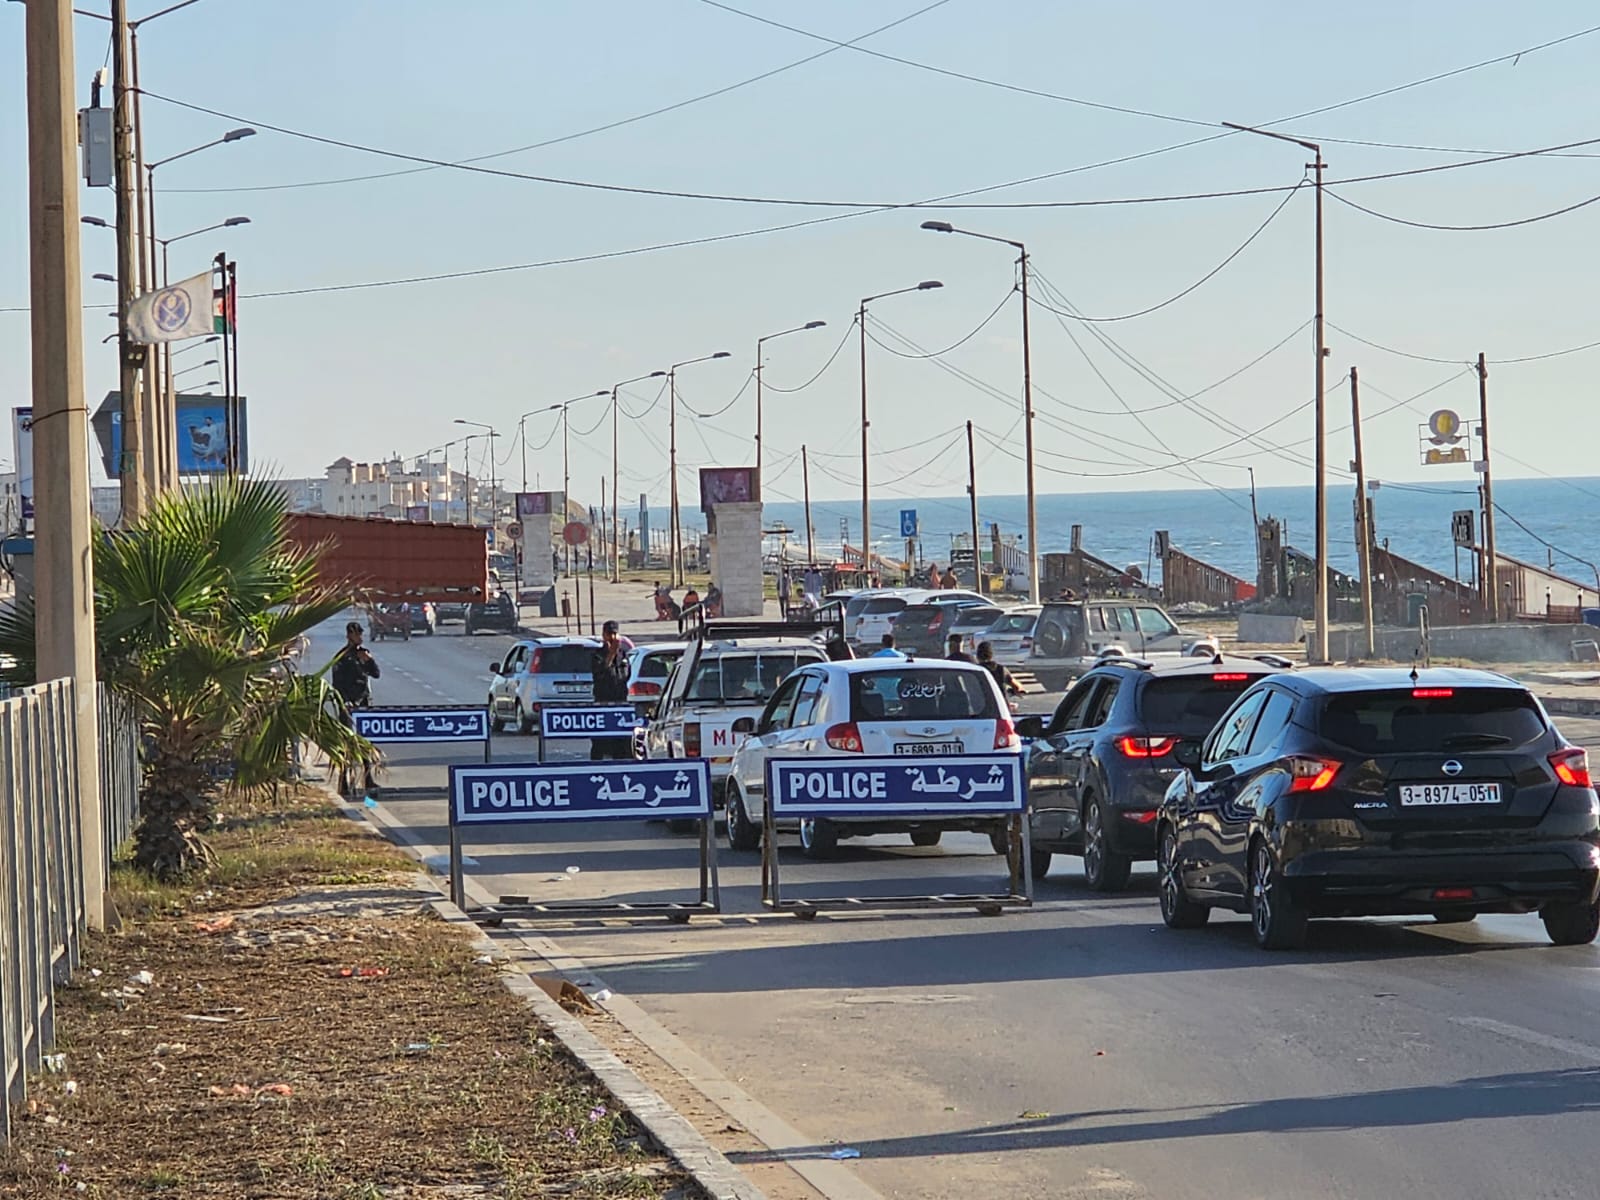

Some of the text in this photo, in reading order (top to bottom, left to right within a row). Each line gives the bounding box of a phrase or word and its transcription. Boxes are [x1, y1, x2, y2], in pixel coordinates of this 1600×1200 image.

[362, 719, 415, 735] POLICE
[424, 715, 479, 735] شرطة
[552, 714, 606, 730] POLICE
[471, 779, 571, 808] POLICE
[590, 770, 692, 807] شرطة
[789, 772, 888, 799] POLICE
[904, 764, 1005, 800] شرطة
[1353, 801, 1389, 809] MICRA
